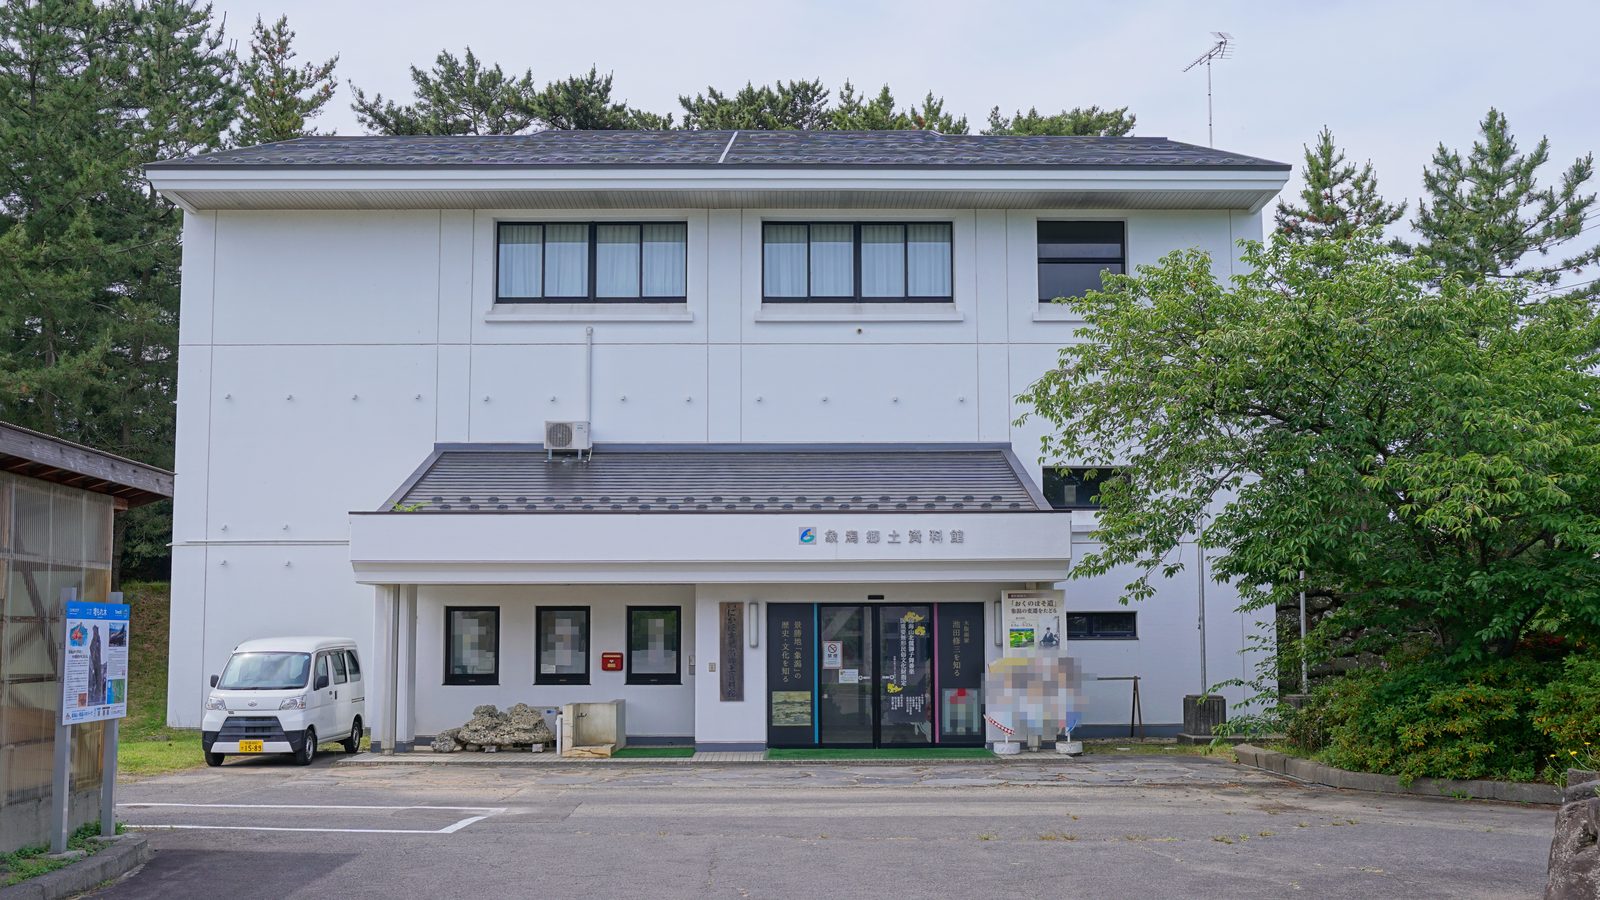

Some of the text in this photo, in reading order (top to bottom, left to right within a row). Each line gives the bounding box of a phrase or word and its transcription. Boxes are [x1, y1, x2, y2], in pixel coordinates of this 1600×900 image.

[825, 529, 964, 544] 象潟郷土資料館
[781, 620, 790, 683] 歴史・文化を知る
[952, 620, 961, 677] 池田修三を知る
